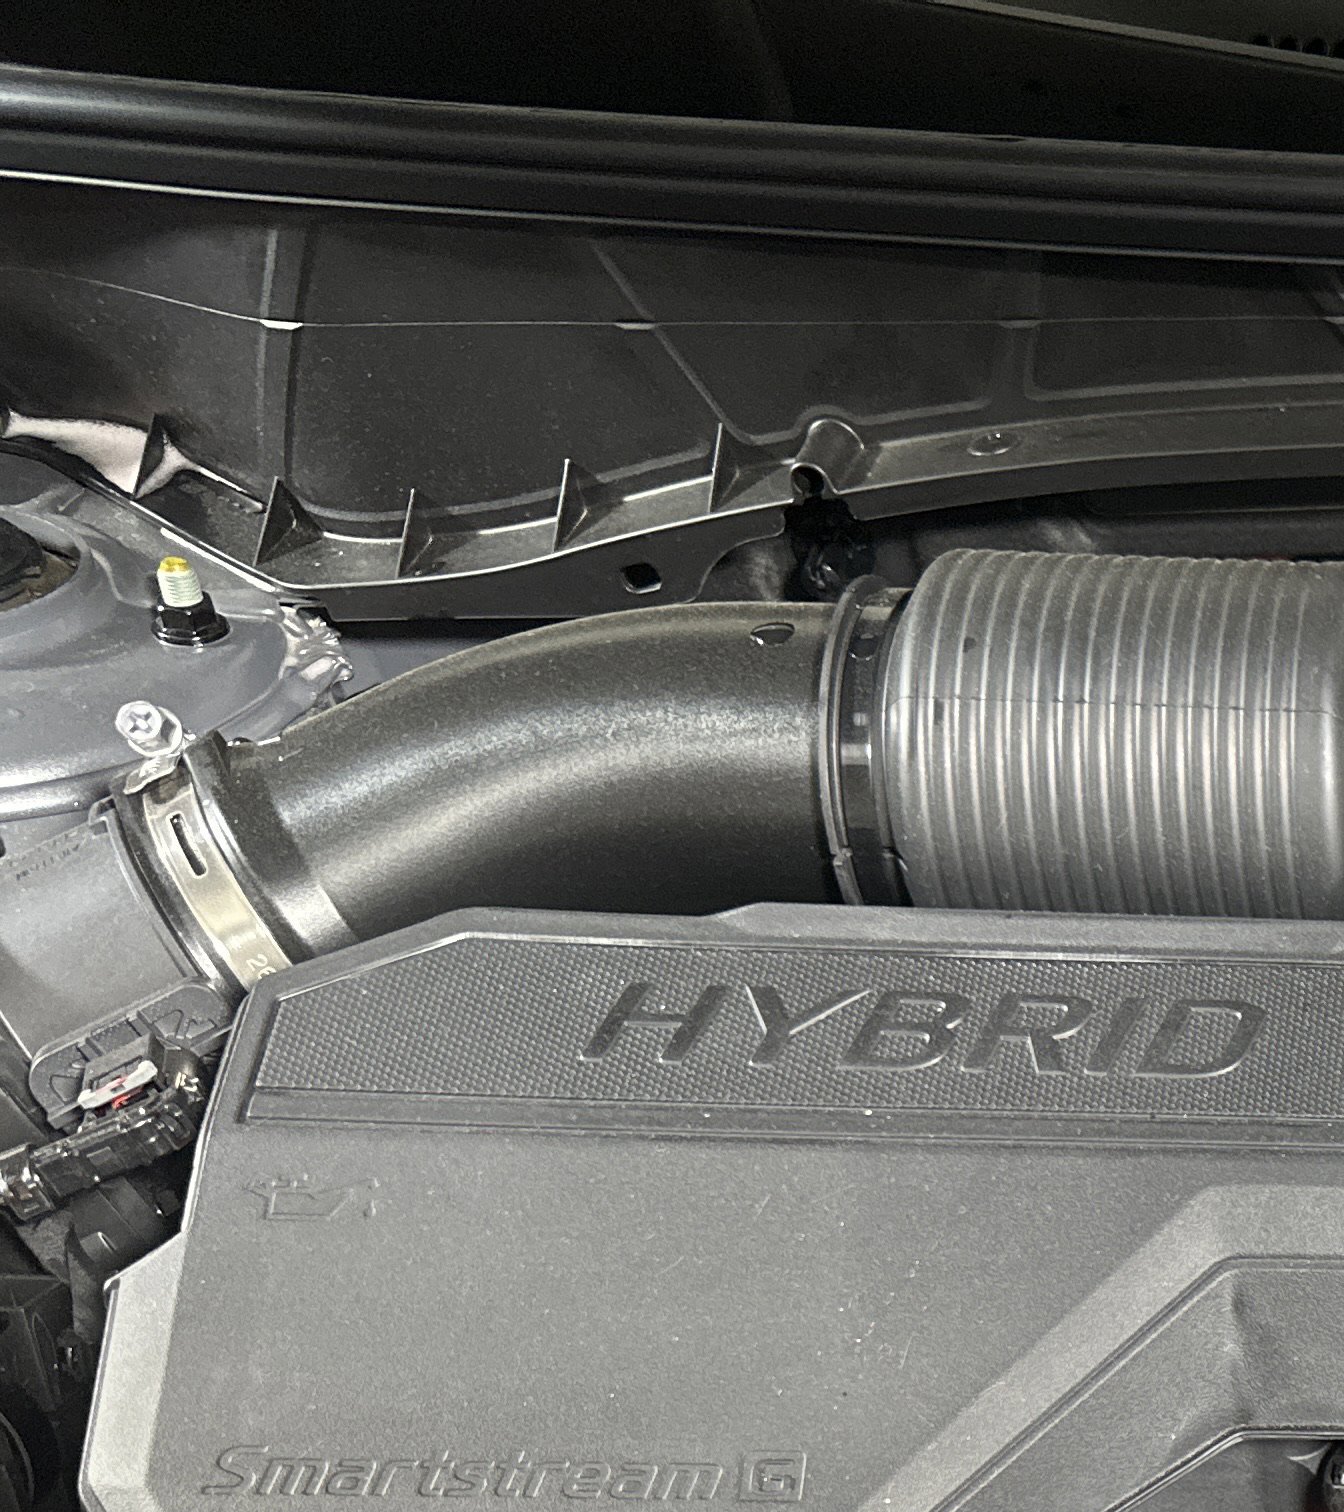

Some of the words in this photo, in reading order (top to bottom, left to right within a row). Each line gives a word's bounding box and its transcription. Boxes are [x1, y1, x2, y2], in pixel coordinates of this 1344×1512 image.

[579, 981, 1267, 1079] HYBRID
[203, 1443, 723, 1502] Smartstream
[742, 1455, 803, 1499] G
